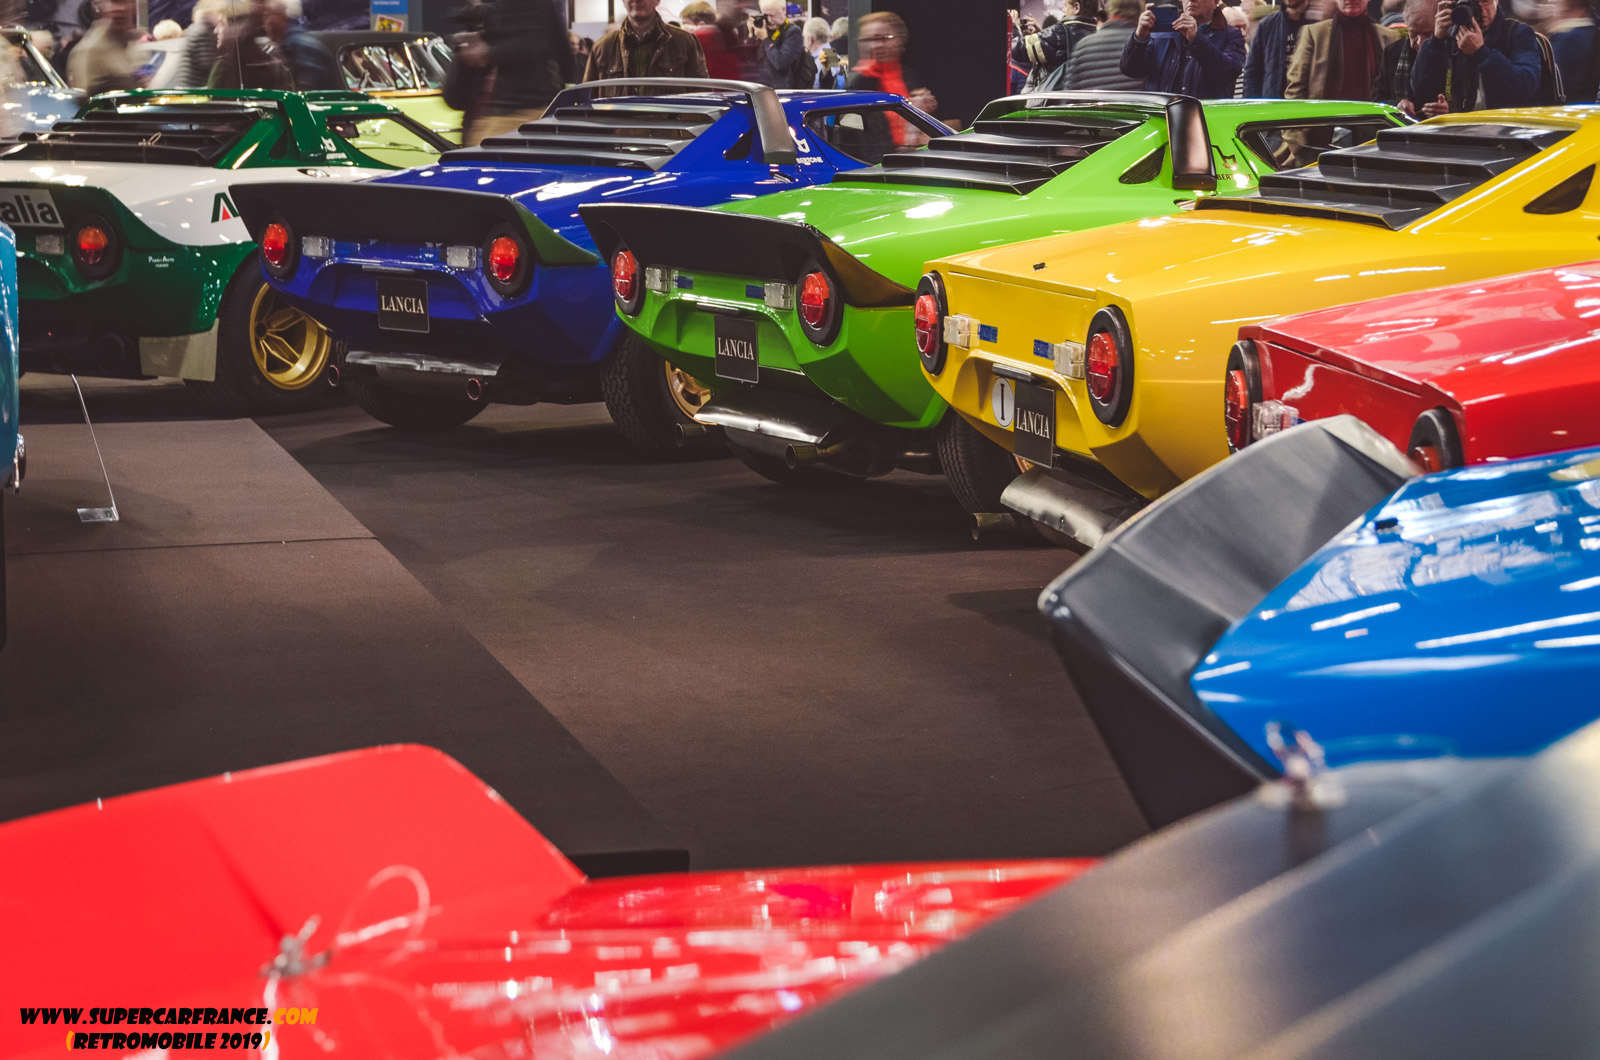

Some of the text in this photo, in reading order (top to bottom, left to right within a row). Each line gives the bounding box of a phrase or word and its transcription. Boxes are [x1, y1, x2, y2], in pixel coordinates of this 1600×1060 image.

[381, 295, 425, 314] LANCIA
[717, 337, 755, 361] LANCIA
[1016, 407, 1050, 439] LANCIA
